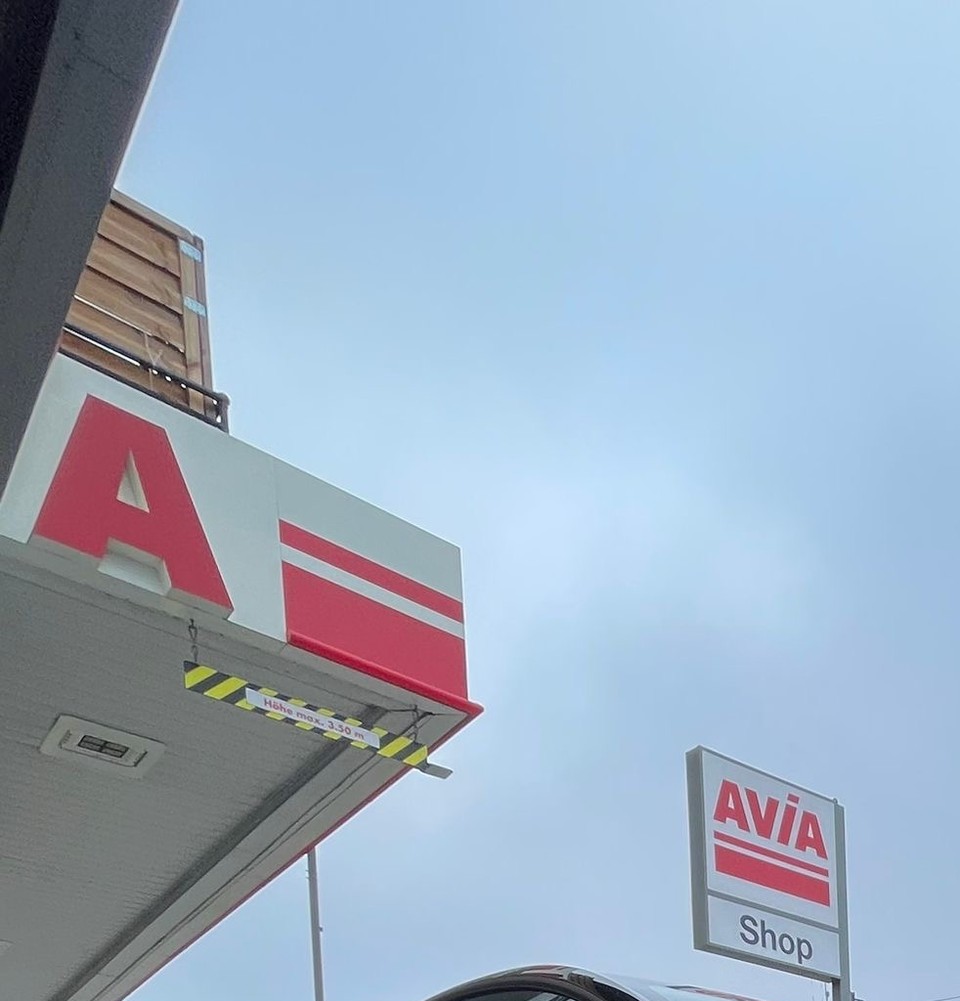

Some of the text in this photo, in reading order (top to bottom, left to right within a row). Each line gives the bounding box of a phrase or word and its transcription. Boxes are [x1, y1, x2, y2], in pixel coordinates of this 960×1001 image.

[34, 393, 233, 611] A
[263, 698, 365, 741] Höhe max. 3.50 m
[713, 778, 829, 860] AVIA
[739, 914, 813, 964] Shop
